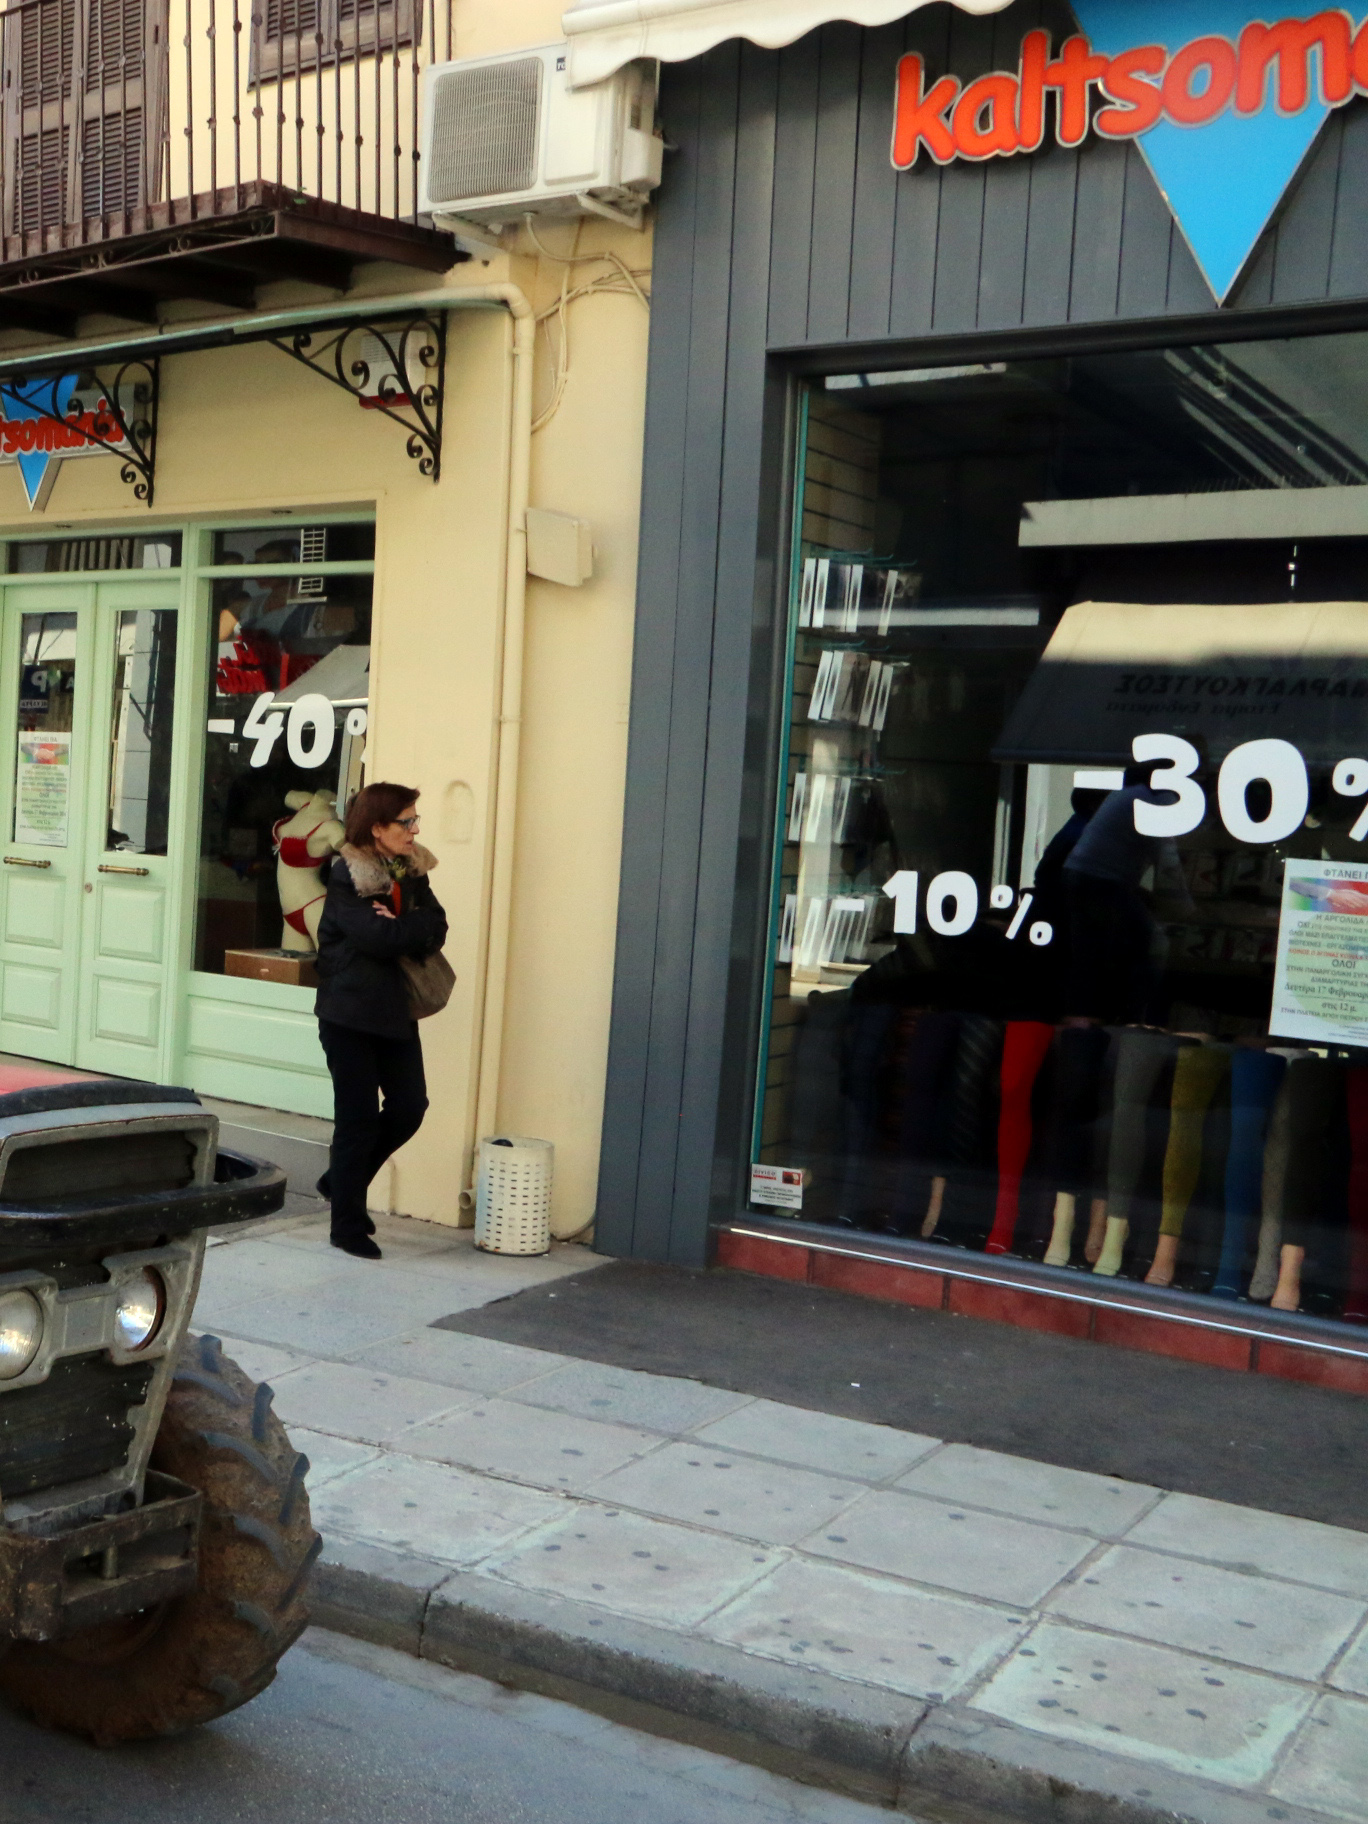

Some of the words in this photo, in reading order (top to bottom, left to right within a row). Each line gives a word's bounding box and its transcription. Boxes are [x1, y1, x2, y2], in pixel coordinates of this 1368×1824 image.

[1323, 868, 1362, 880] ΦΤΑΝΕΙ
[1332, 959, 1356, 969] ΟΛΟΙ
[1340, 1002, 1349, 1011] 12
